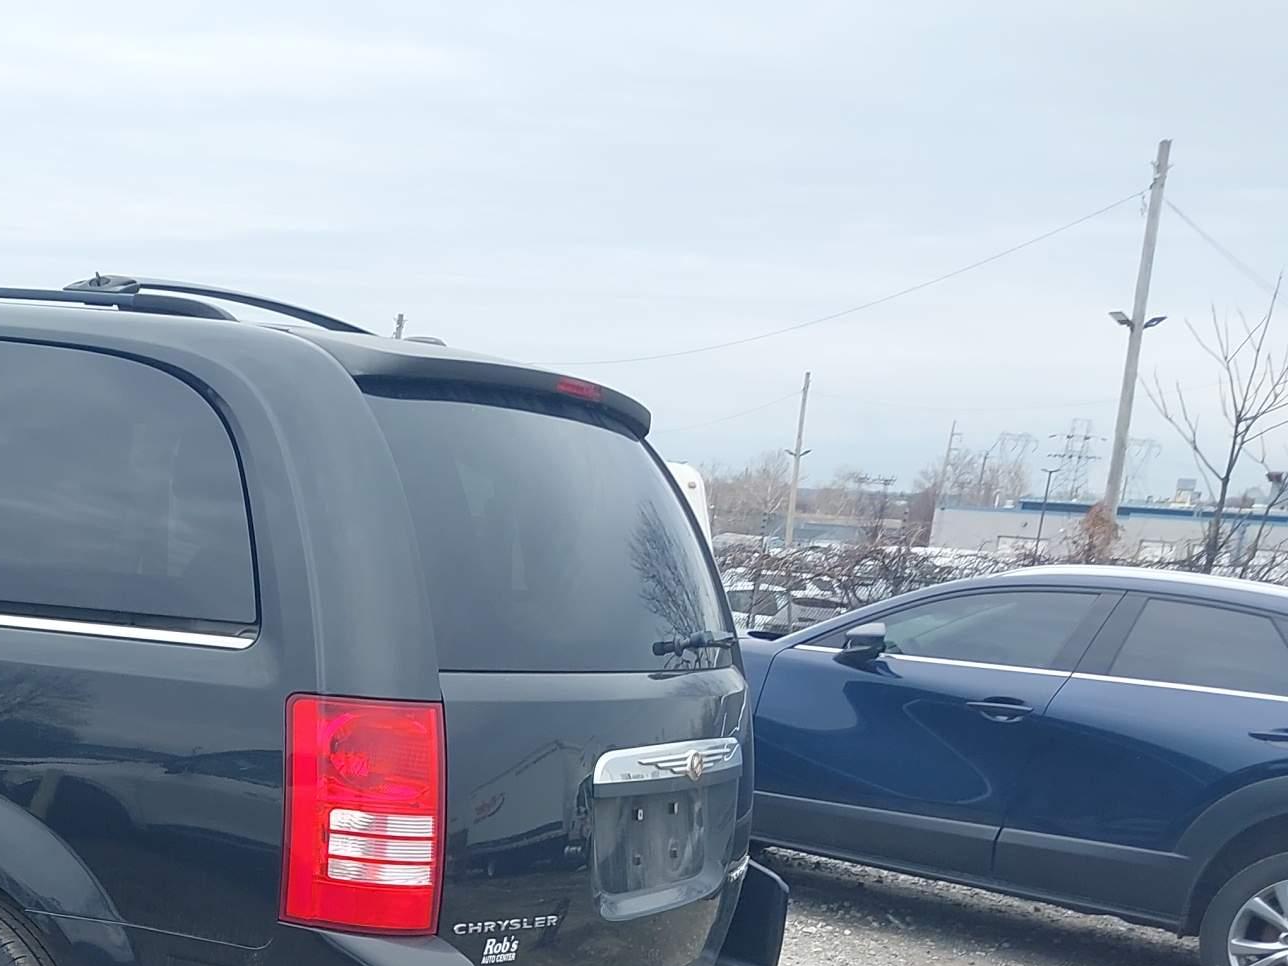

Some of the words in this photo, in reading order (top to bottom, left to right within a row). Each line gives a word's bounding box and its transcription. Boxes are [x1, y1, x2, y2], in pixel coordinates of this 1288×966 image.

[453, 915, 558, 935] CHRYSLER
[483, 935, 519, 955] Rob's
[481, 954, 496, 965] AUTO
[495, 952, 516, 962] CENTER
